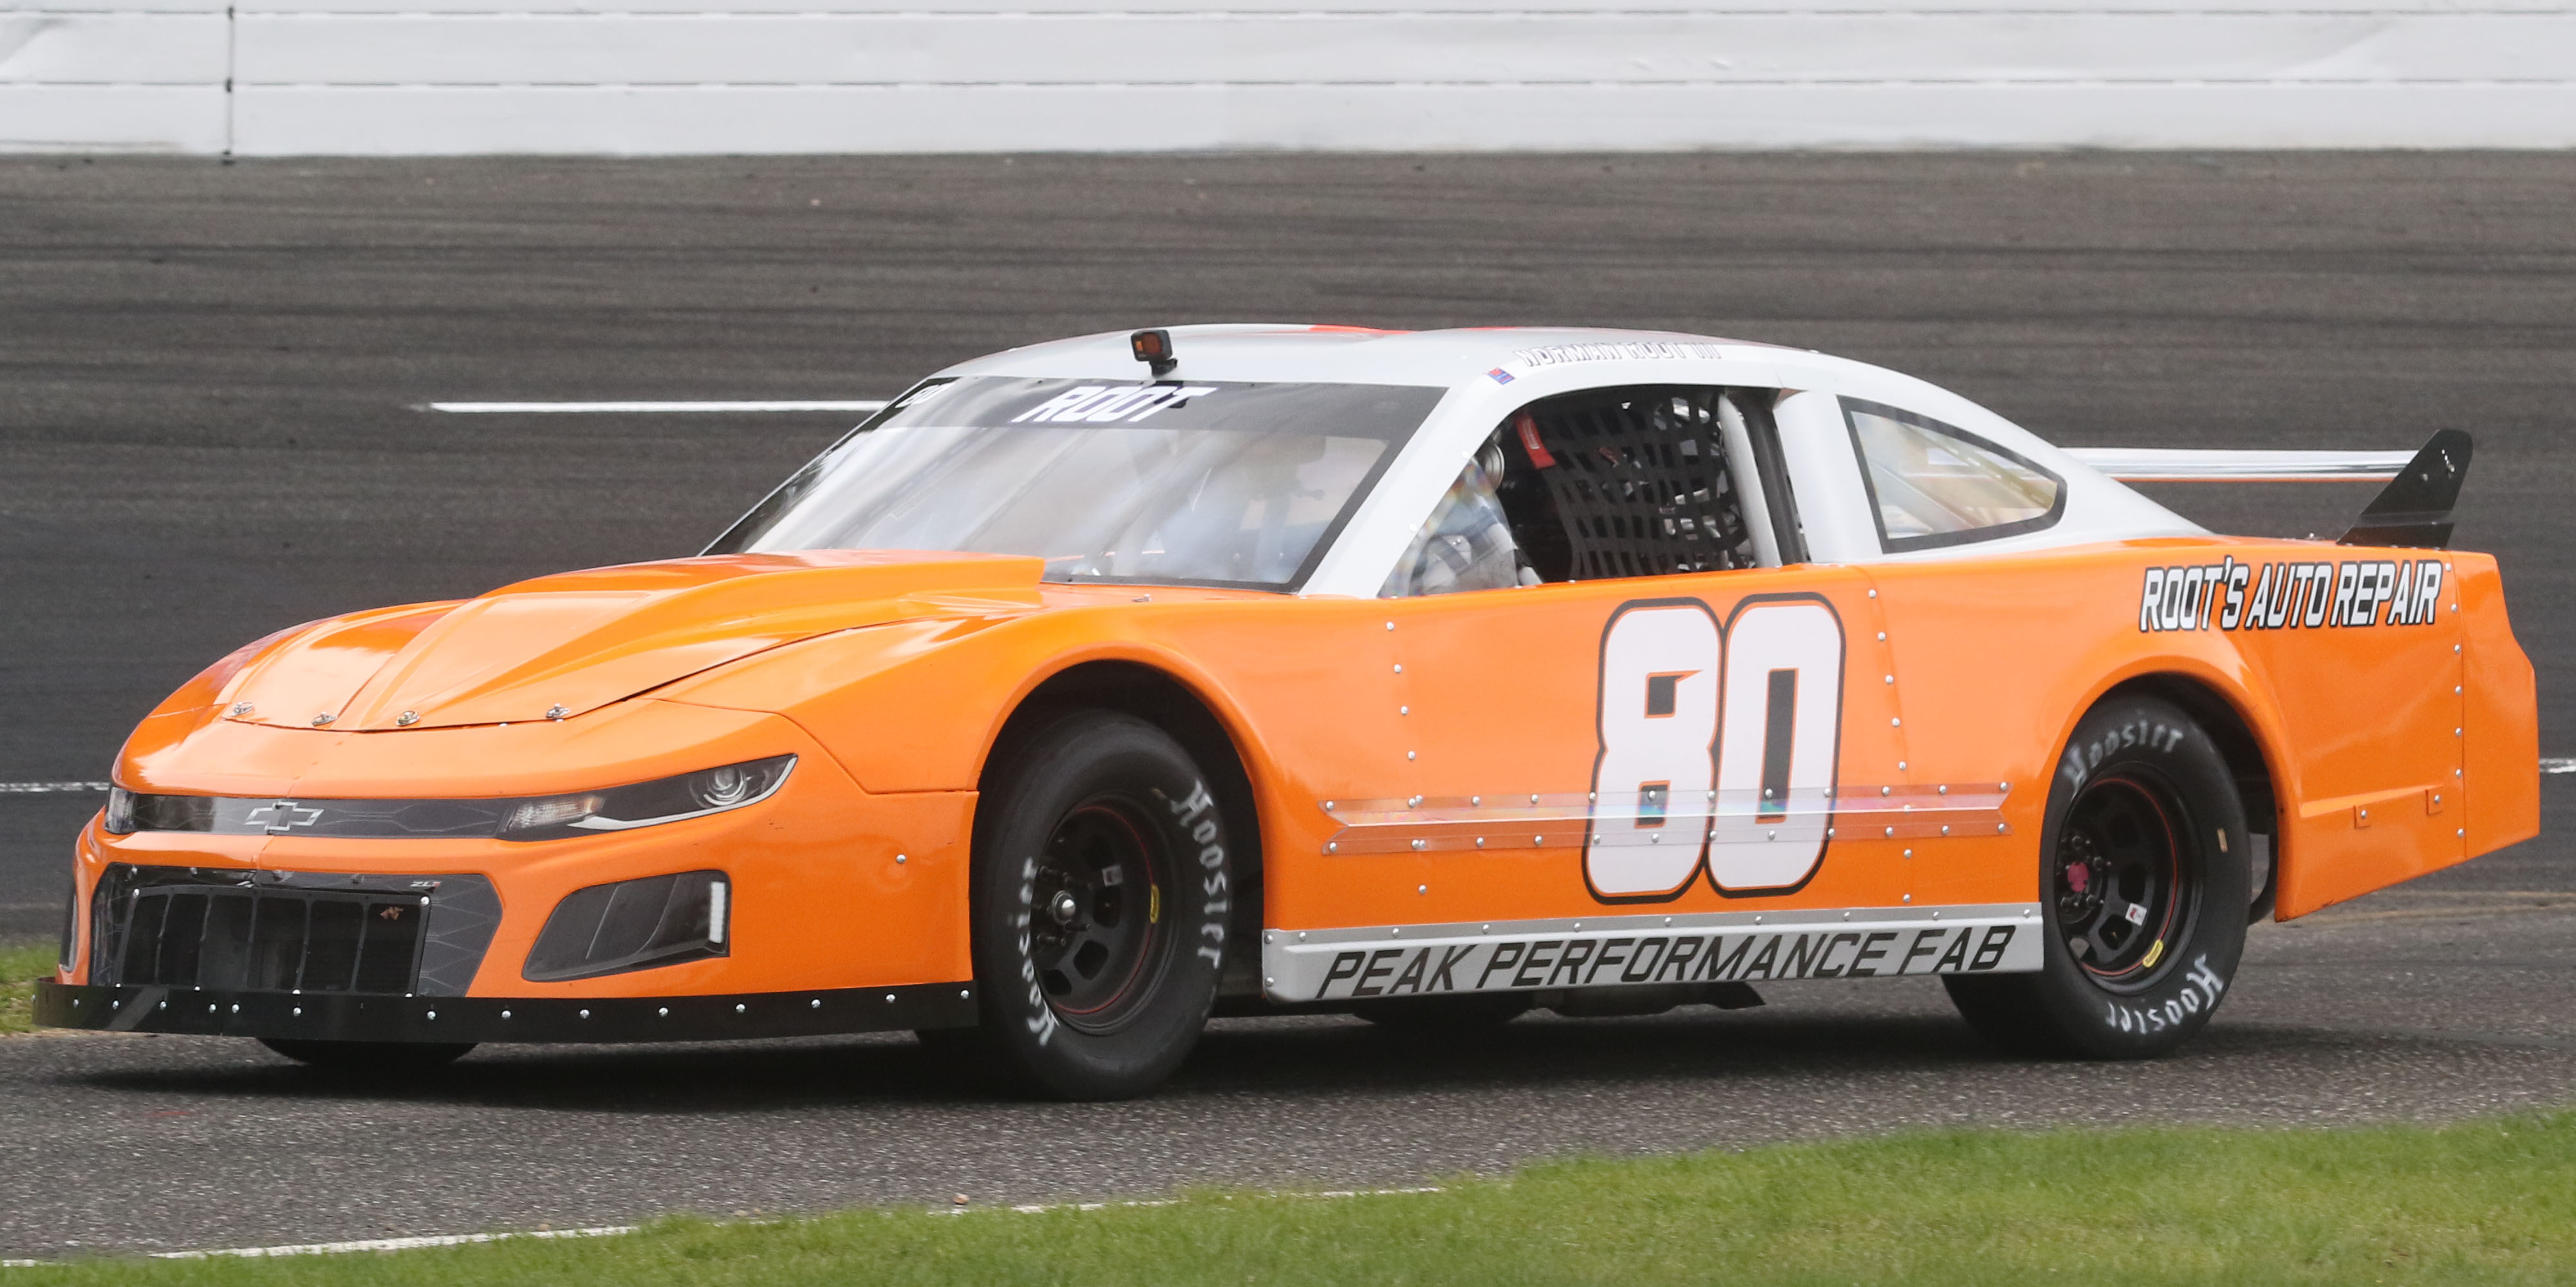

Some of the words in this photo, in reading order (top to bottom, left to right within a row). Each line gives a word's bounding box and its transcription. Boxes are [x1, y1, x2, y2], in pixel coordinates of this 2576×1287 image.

[1011, 386, 1218, 424] ROOT
[2139, 555, 2250, 632] ROOT'S
[2244, 562, 2334, 629] AUTO
[2329, 560, 2443, 628] REPAIR
[1582, 591, 1847, 906] 80
[2064, 718, 2184, 800] Hoosier
[1170, 778, 1229, 969] Hoosier
[1314, 944, 1478, 999] PEAK
[1475, 932, 1899, 990] PERFORMANCE
[1896, 925, 2017, 976] FAB
[2105, 952, 2225, 1035] Hoosier
